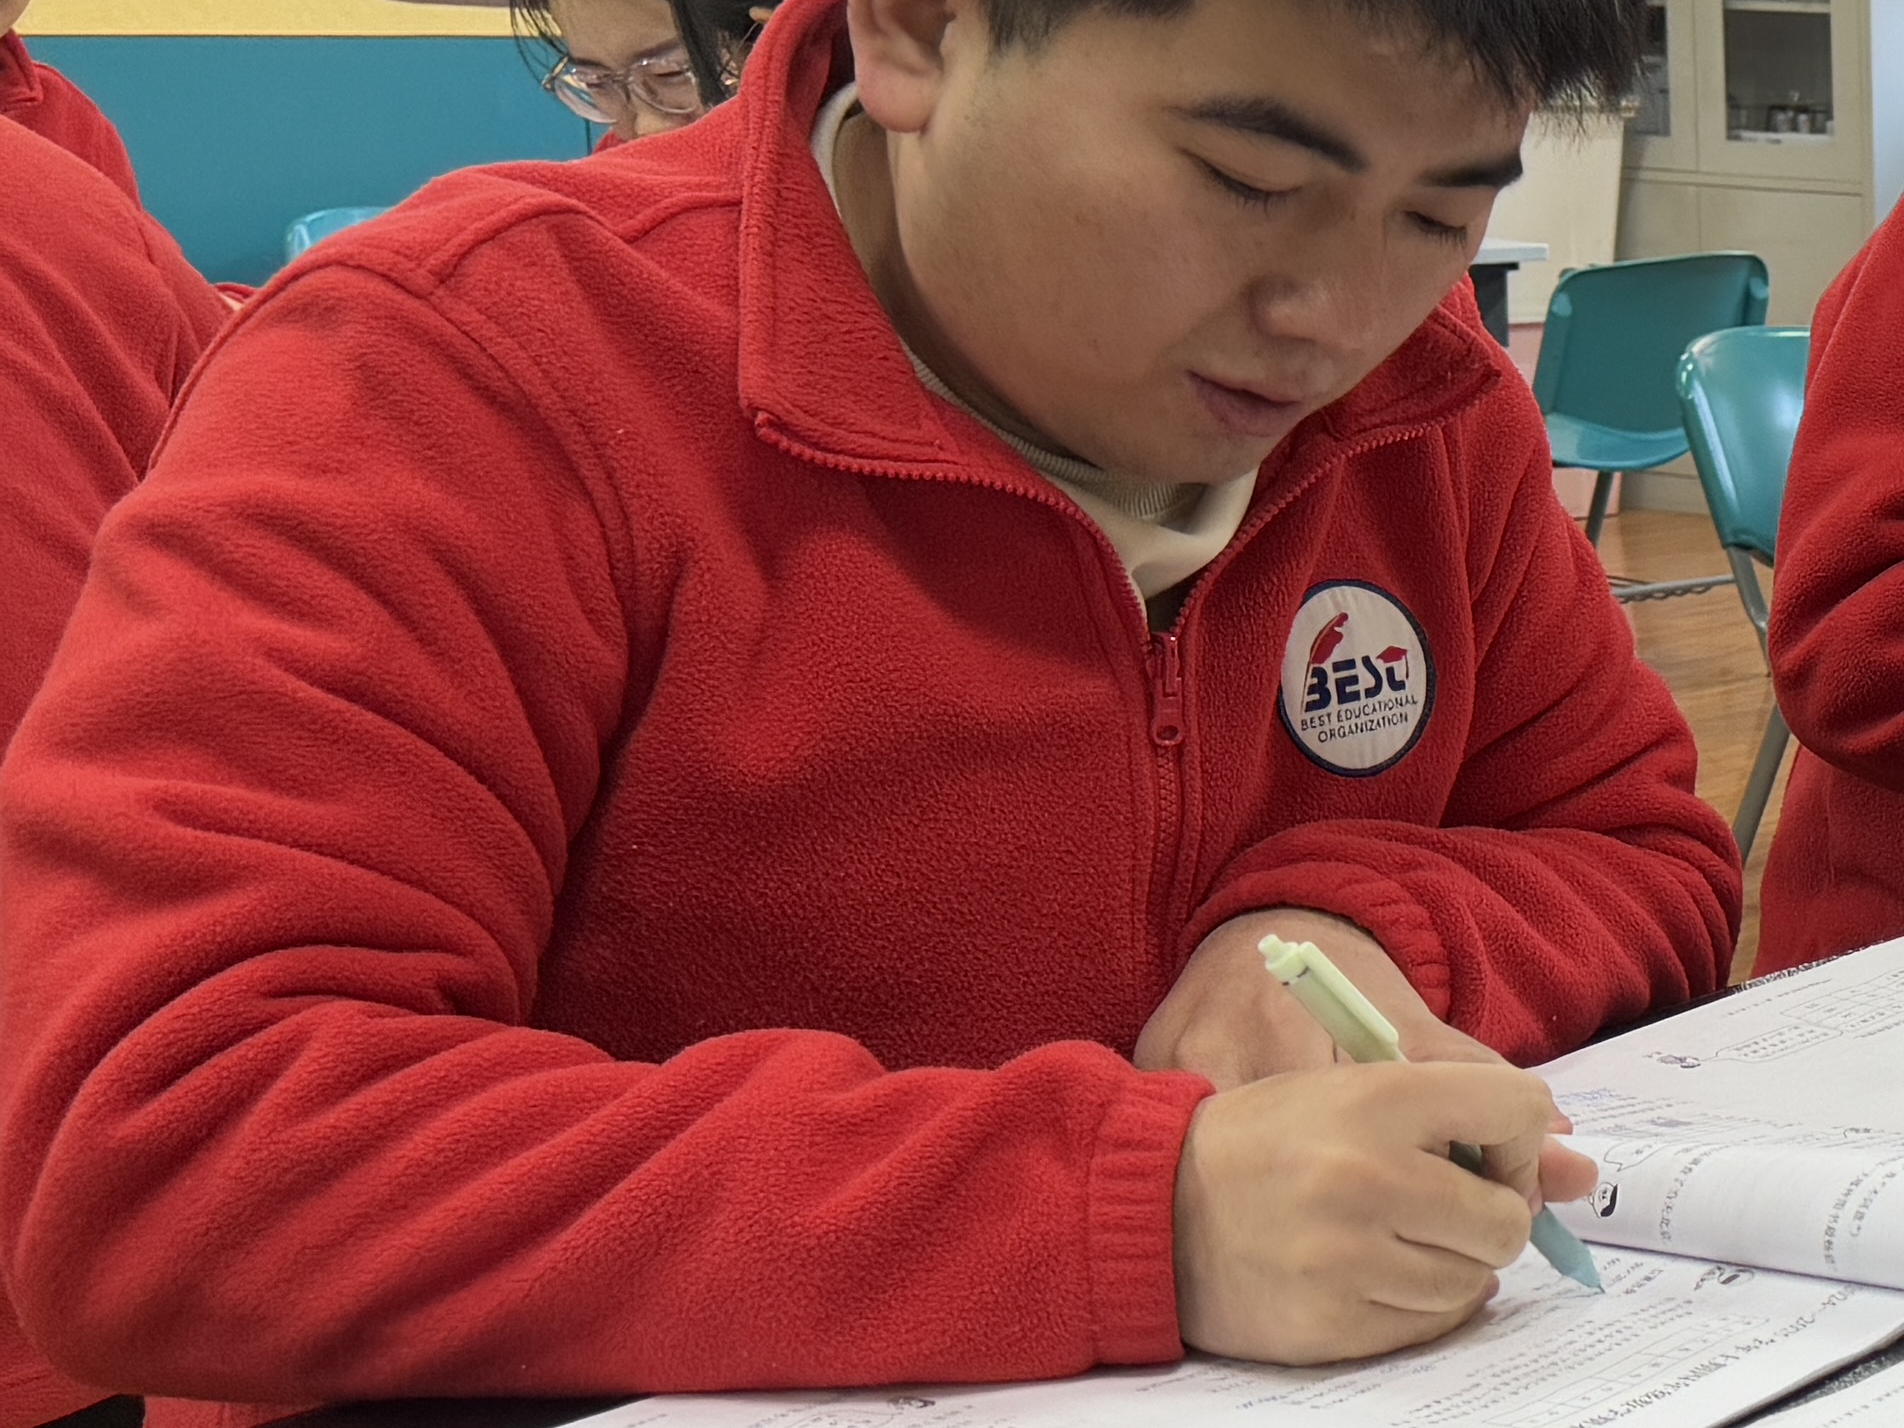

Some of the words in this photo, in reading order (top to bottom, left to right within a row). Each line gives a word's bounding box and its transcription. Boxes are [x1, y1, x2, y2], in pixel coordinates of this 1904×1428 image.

[1304, 648, 1410, 712] BEST
[1301, 712, 1333, 731] BEST
[1336, 695, 1418, 723] EDUCATIONAL
[1317, 712, 1408, 743] ORGANIZATION
